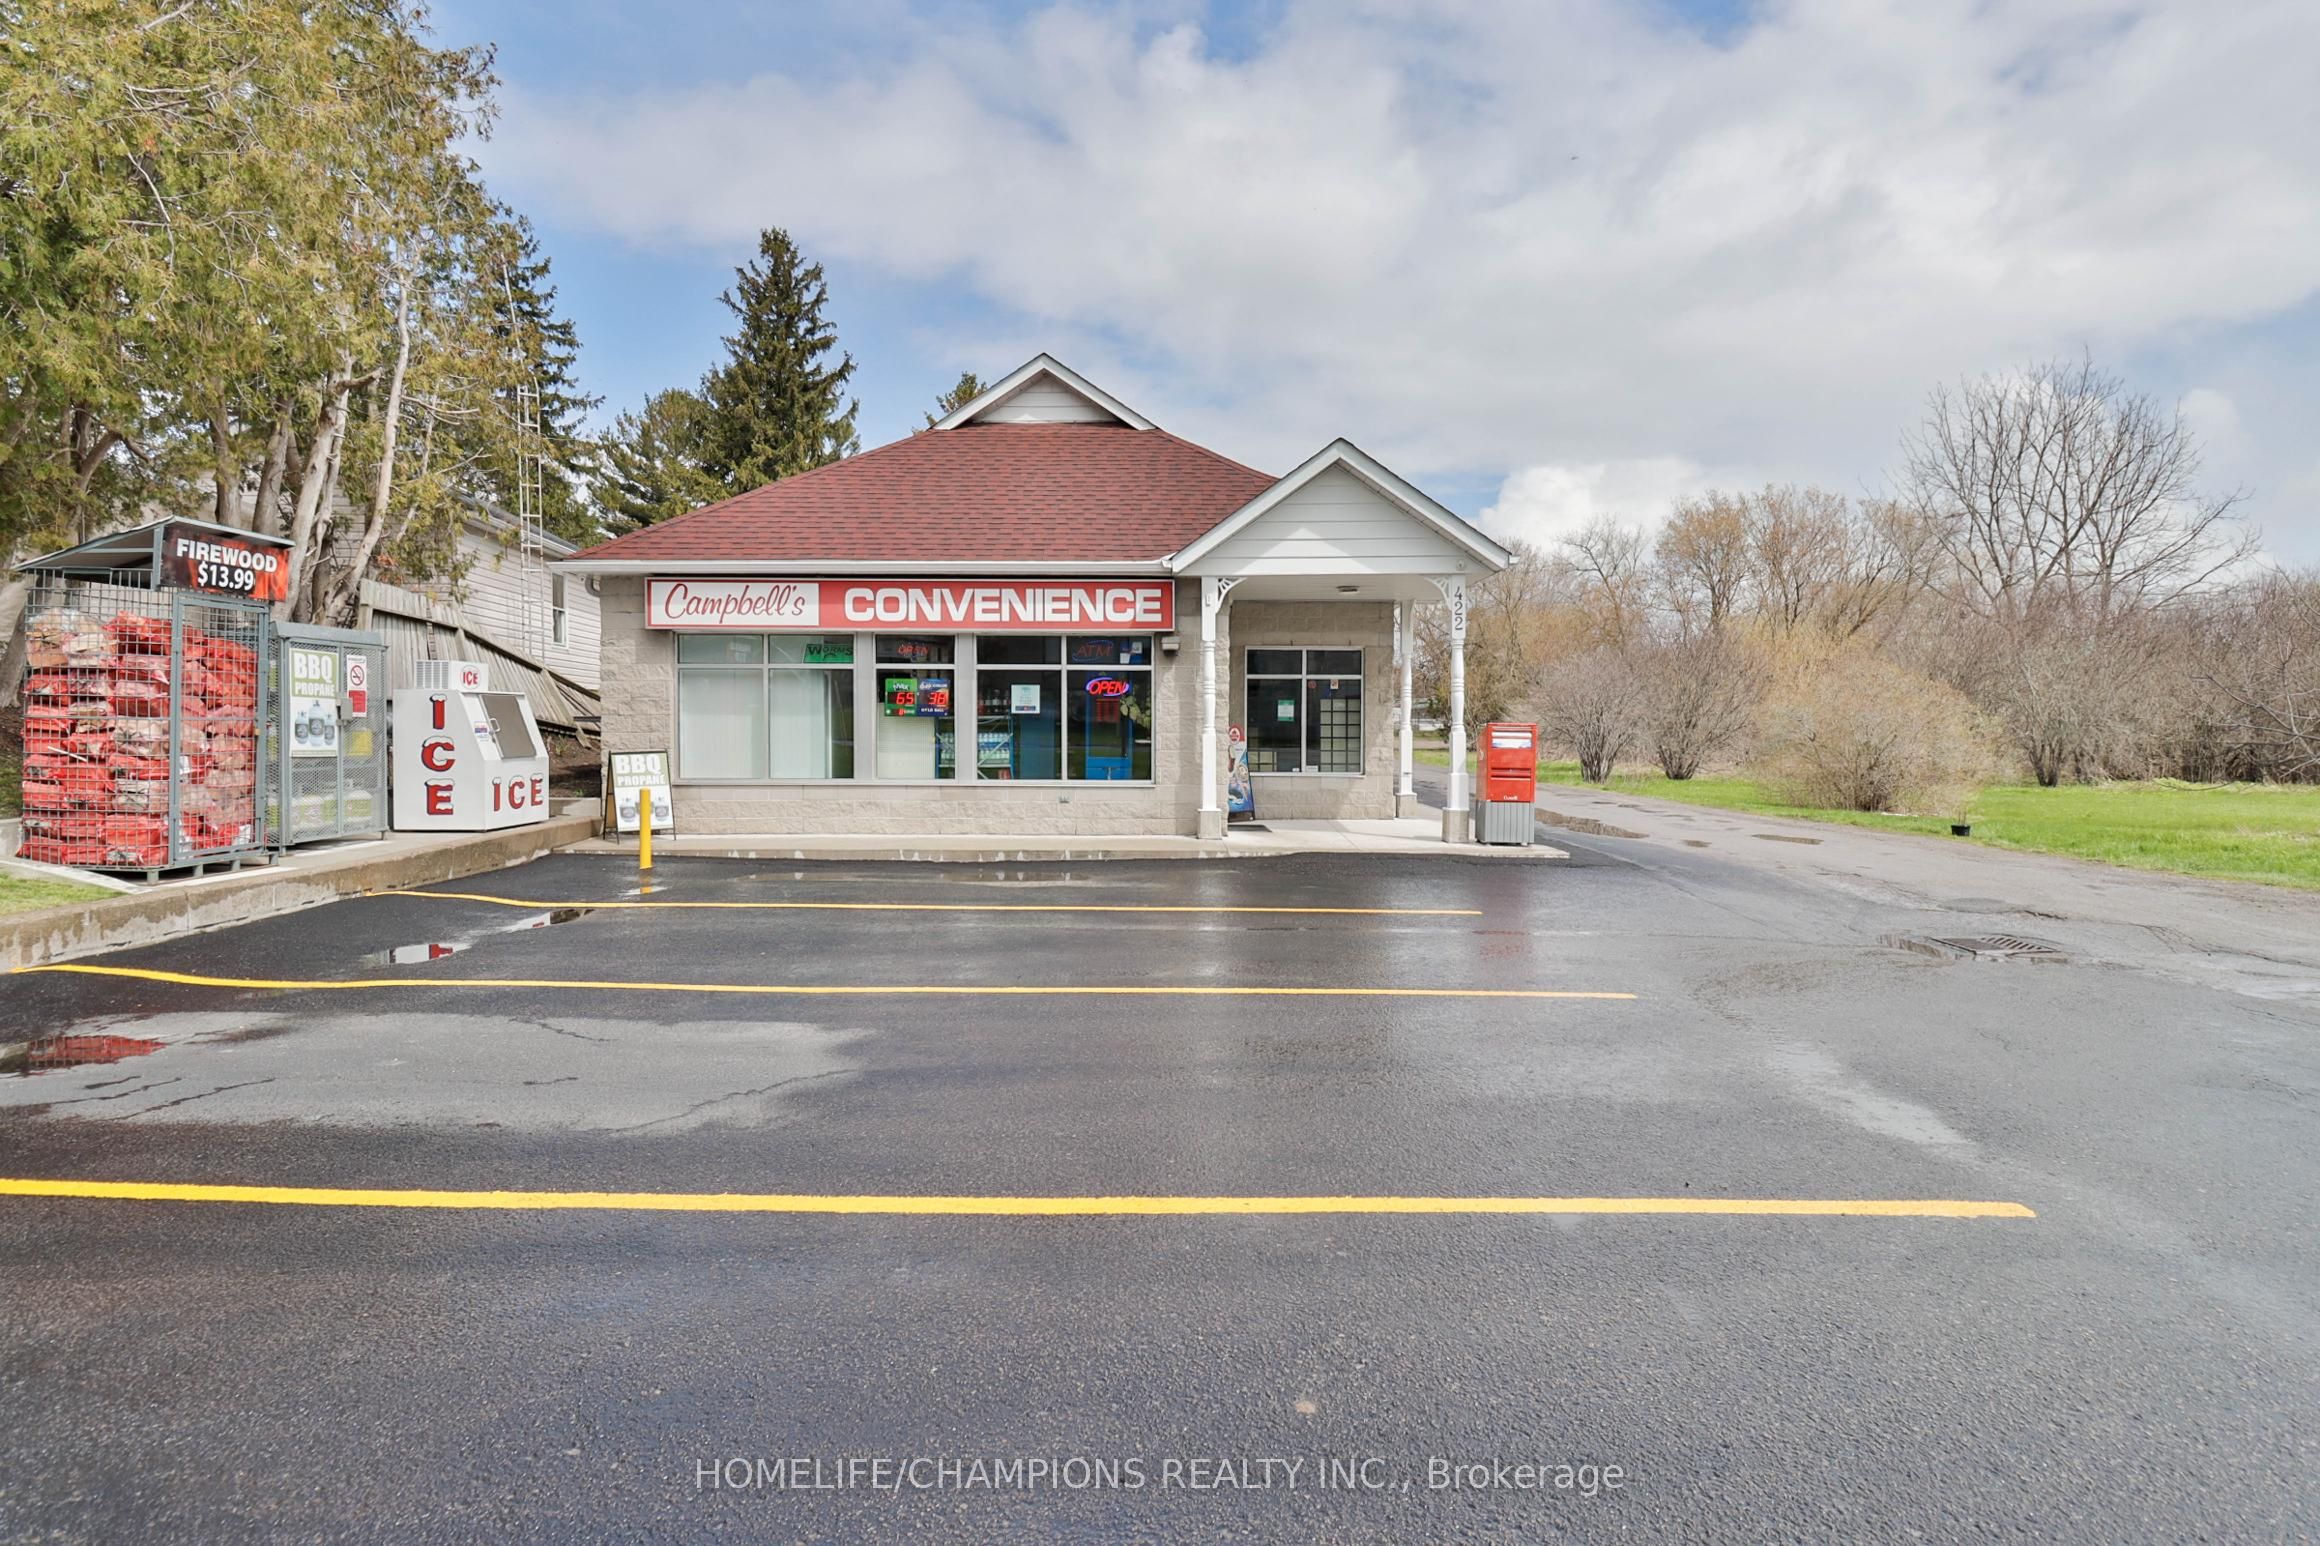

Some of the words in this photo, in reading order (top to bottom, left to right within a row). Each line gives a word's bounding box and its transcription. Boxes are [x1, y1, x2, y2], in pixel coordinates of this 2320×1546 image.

[176, 538, 278, 573] FIREWOOD
[197, 560, 254, 591] $13.99
[664, 582, 806, 624] Campbell's
[844, 588, 1162, 622] CONVENIENCE
[1454, 585, 1463, 630] 422
[1076, 644, 1112, 657] ATM
[293, 652, 333, 683] BBQ
[463, 671, 479, 686] ICE
[295, 681, 336, 697] PROPANE
[1089, 681, 1125, 695] OPEN
[421, 693, 456, 815] ICE
[615, 754, 662, 775] BBQ
[492, 773, 544, 812] ICE
[617, 774, 666, 786] PROPANE
